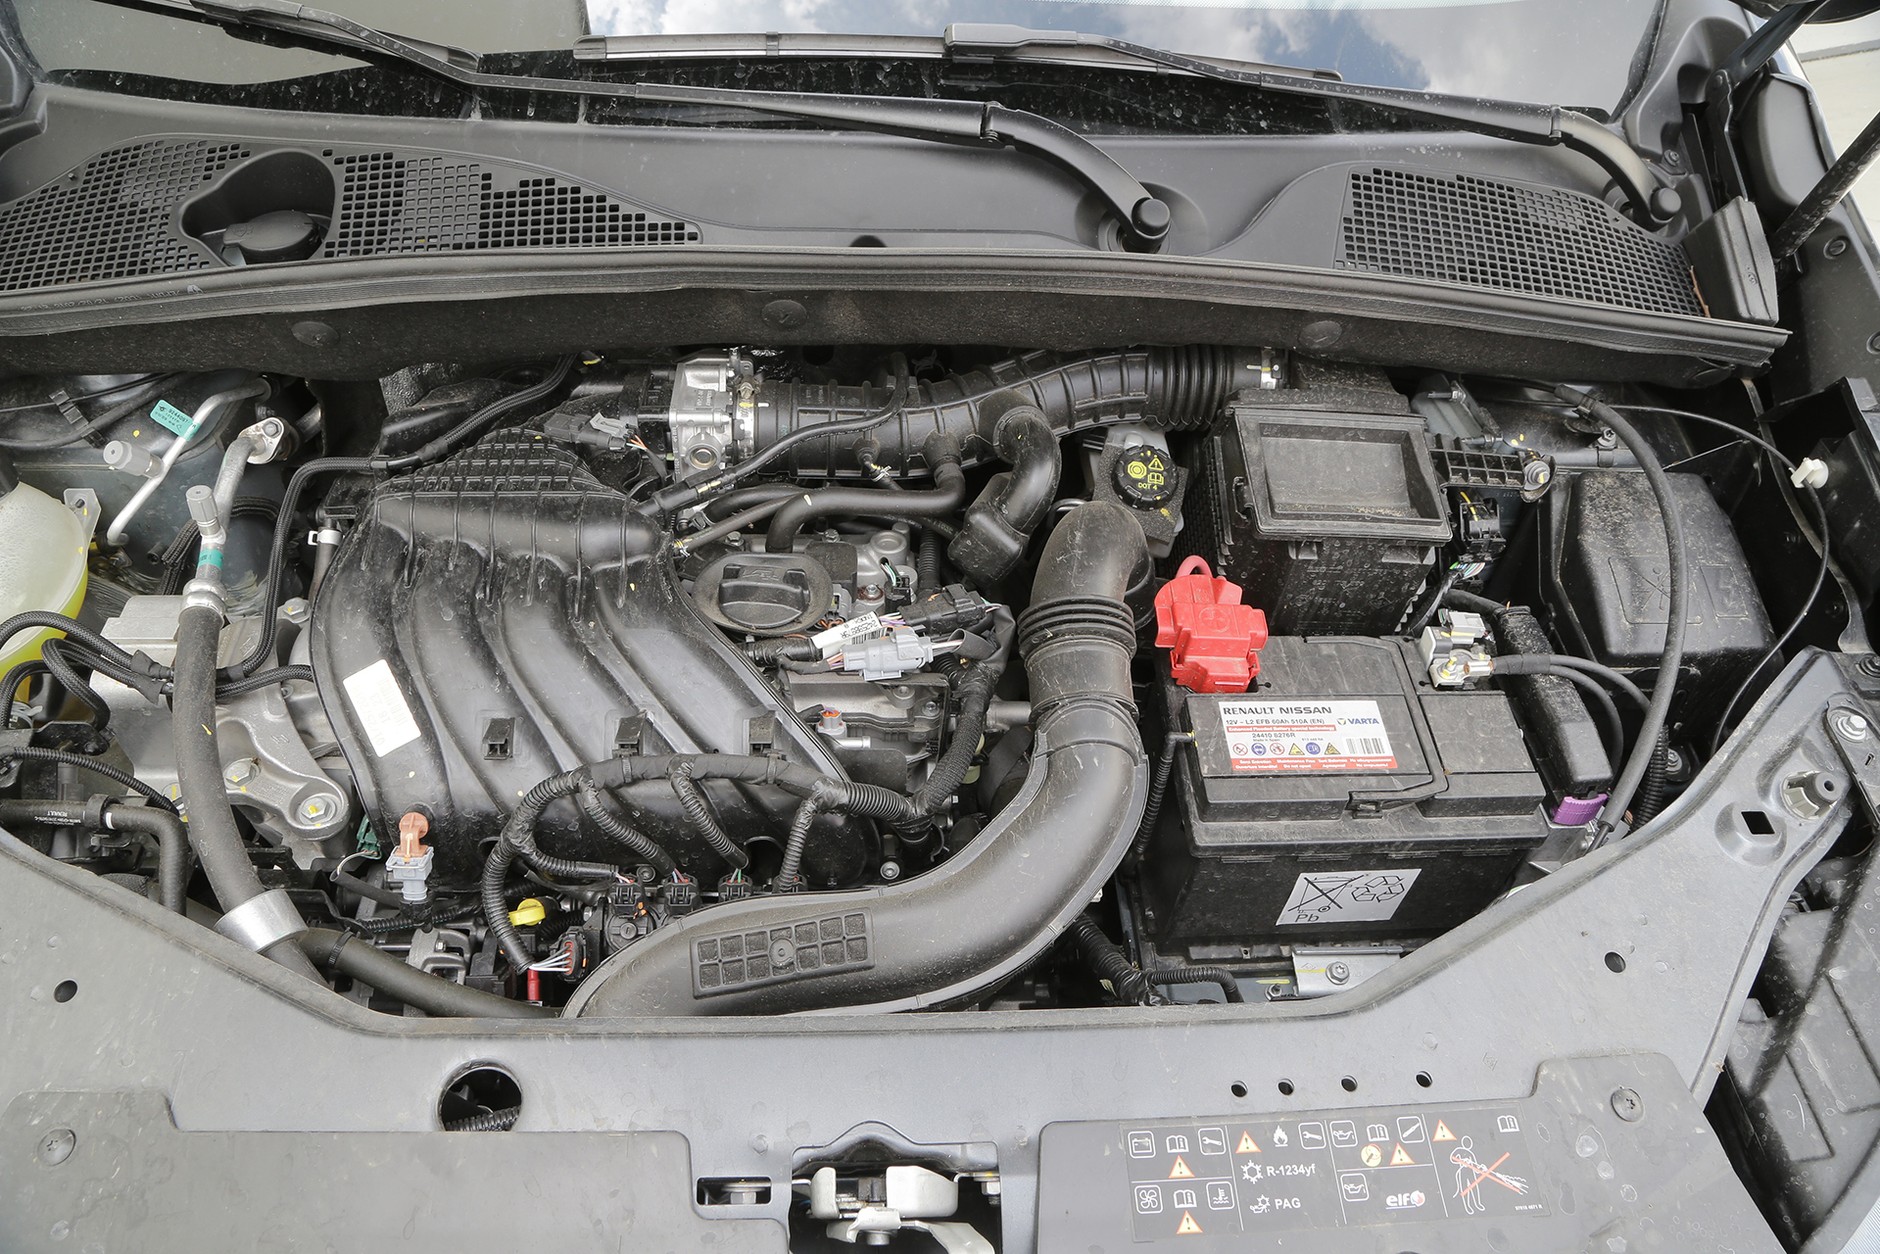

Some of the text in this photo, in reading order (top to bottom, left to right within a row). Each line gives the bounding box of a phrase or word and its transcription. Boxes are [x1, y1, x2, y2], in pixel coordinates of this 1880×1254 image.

[1223, 706, 1332, 715] RENAULT NISSAN
[1295, 913, 1319, 922] Pb
[1266, 1163, 1316, 1178] R-1234yf
[1274, 1197, 1301, 1210] PAG
[1386, 1192, 1411, 1207] elf
